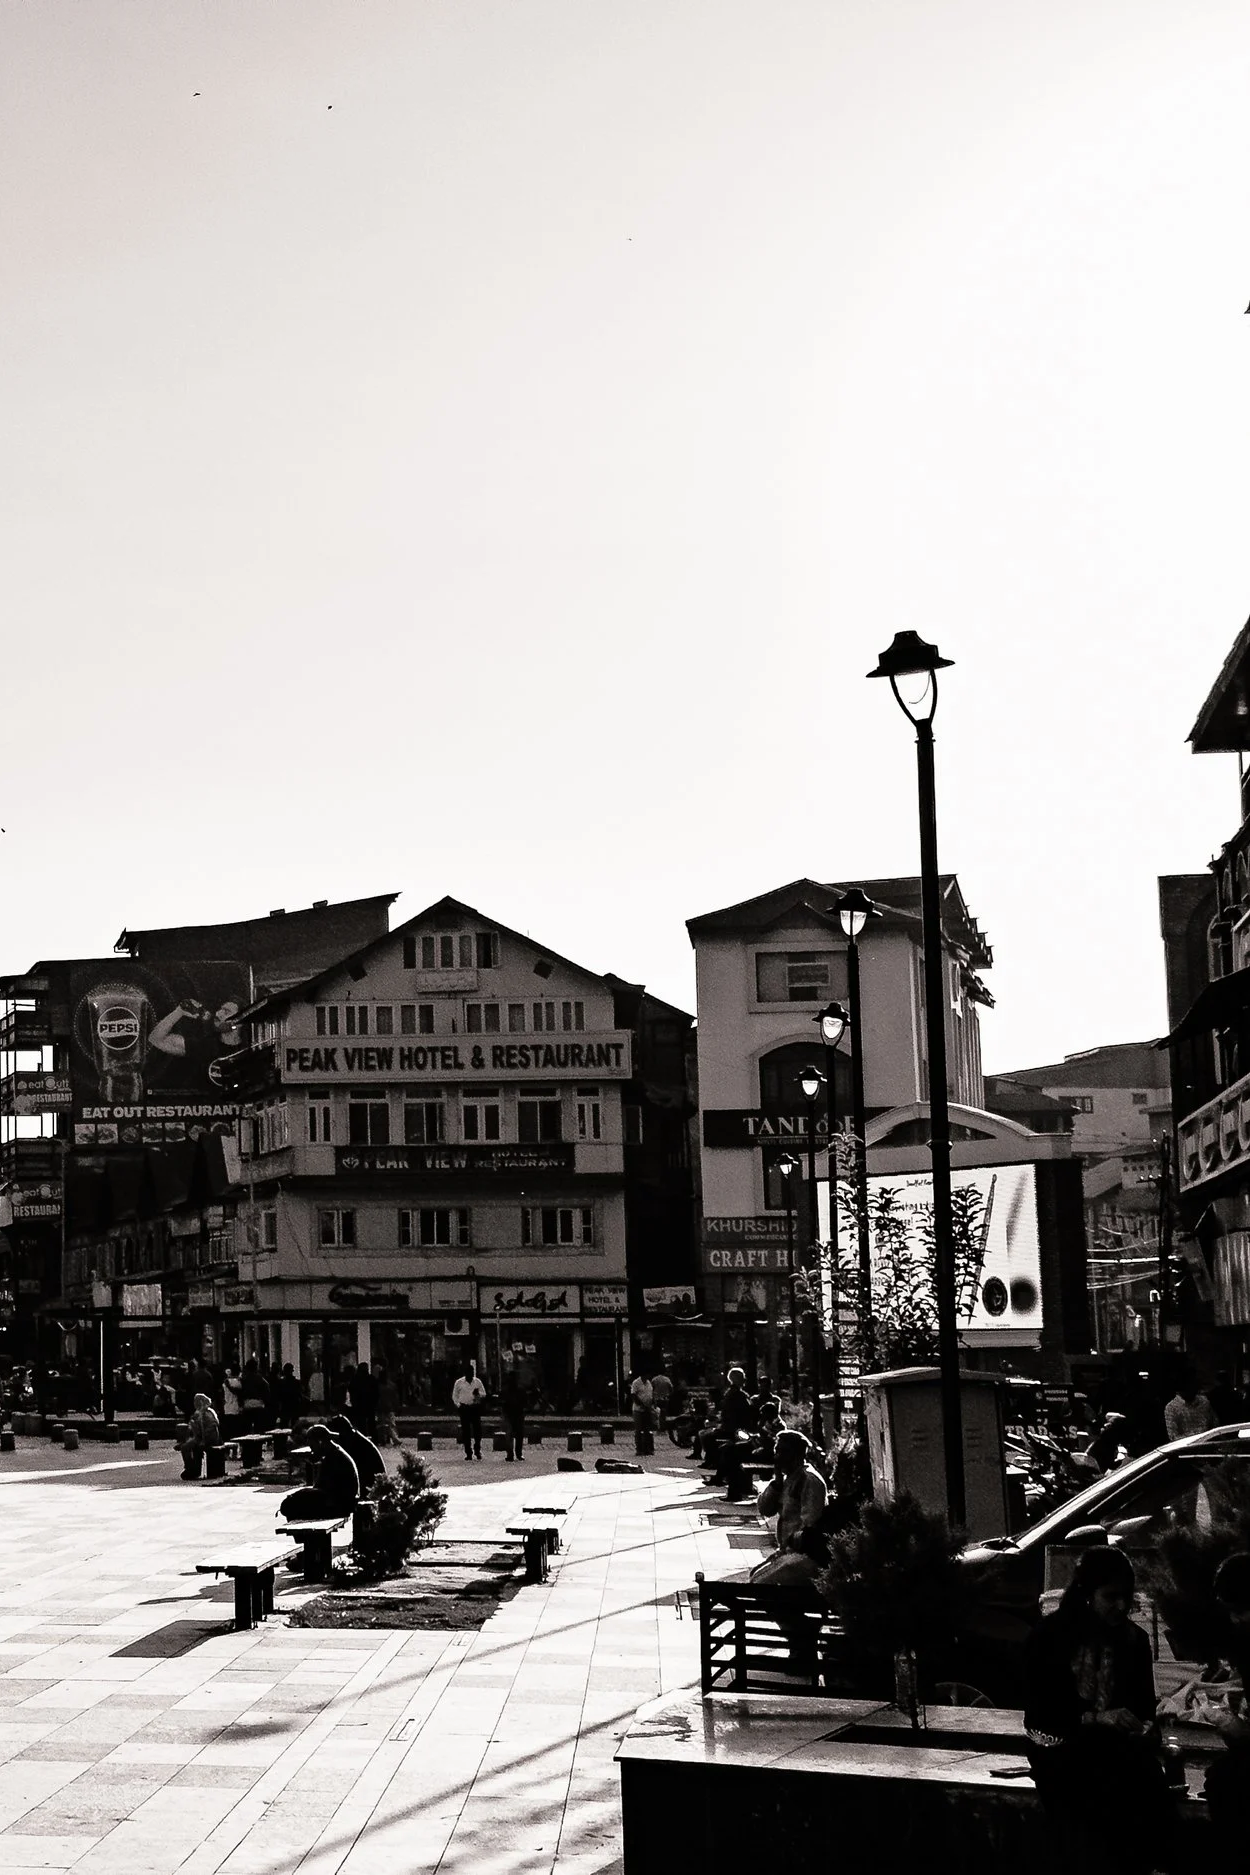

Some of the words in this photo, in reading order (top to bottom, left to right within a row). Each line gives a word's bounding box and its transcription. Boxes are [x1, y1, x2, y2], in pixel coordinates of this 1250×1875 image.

[100, 1023, 138, 1033] PEPSI
[286, 1047, 338, 1072] PEAK
[343, 1046, 393, 1072] VIEW
[400, 1045, 465, 1071] HOTEL
[470, 1045, 486, 1070] &
[491, 1043, 625, 1069] RESTAURANT
[82, 1106, 111, 1119] EAT
[113, 1106, 144, 1118] OUT
[146, 1104, 241, 1118] RESTAURANT
[423, 1151, 467, 1169] VIEW
[474, 1158, 567, 1168] RESTAURANT
[709, 1249, 768, 1268] CRAFT
